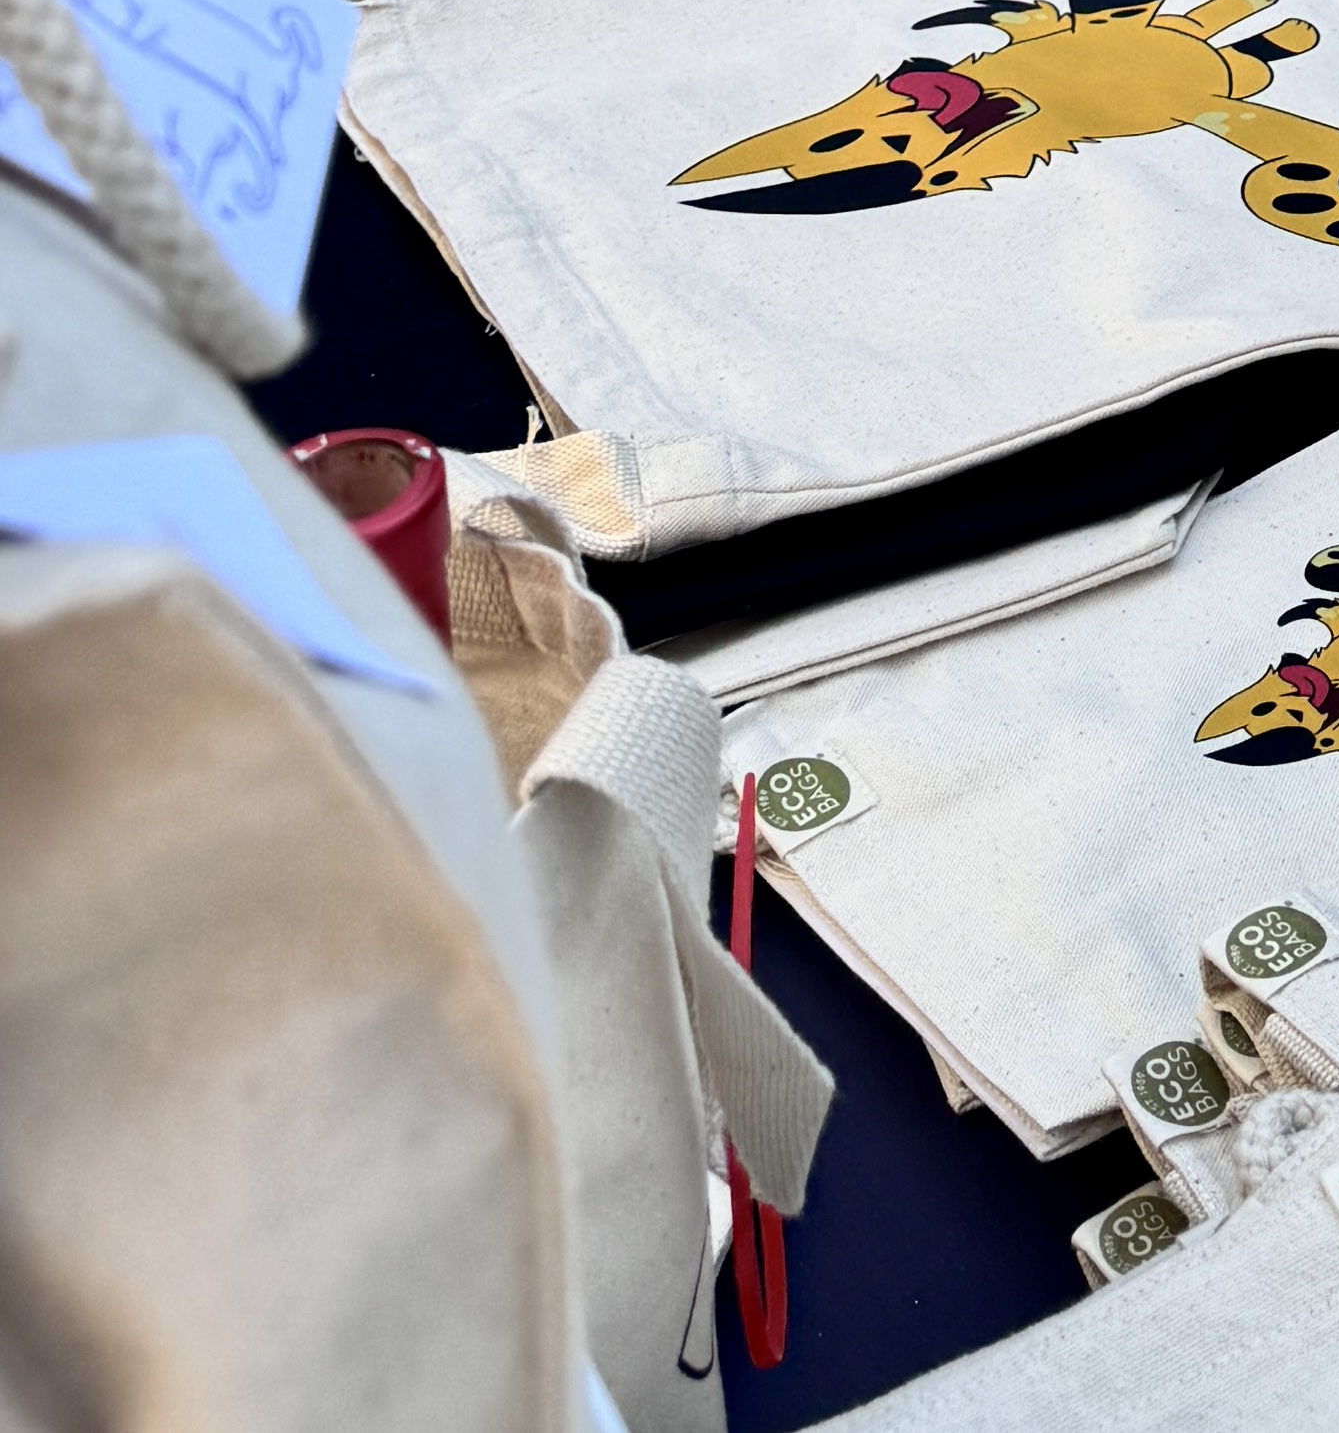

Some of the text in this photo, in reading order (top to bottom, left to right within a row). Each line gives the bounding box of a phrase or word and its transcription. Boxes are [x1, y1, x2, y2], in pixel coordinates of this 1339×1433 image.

[769, 772, 818, 827] ECO
[789, 761, 841, 815] BAGS
[1238, 925, 1295, 973] ECO
[1258, 911, 1317, 958] BAGS
[1145, 1057, 1195, 1121] ECO
[1167, 1046, 1219, 1114] BAGS
[1112, 1216, 1156, 1259] CO
[1132, 1201, 1178, 1240] AGS
